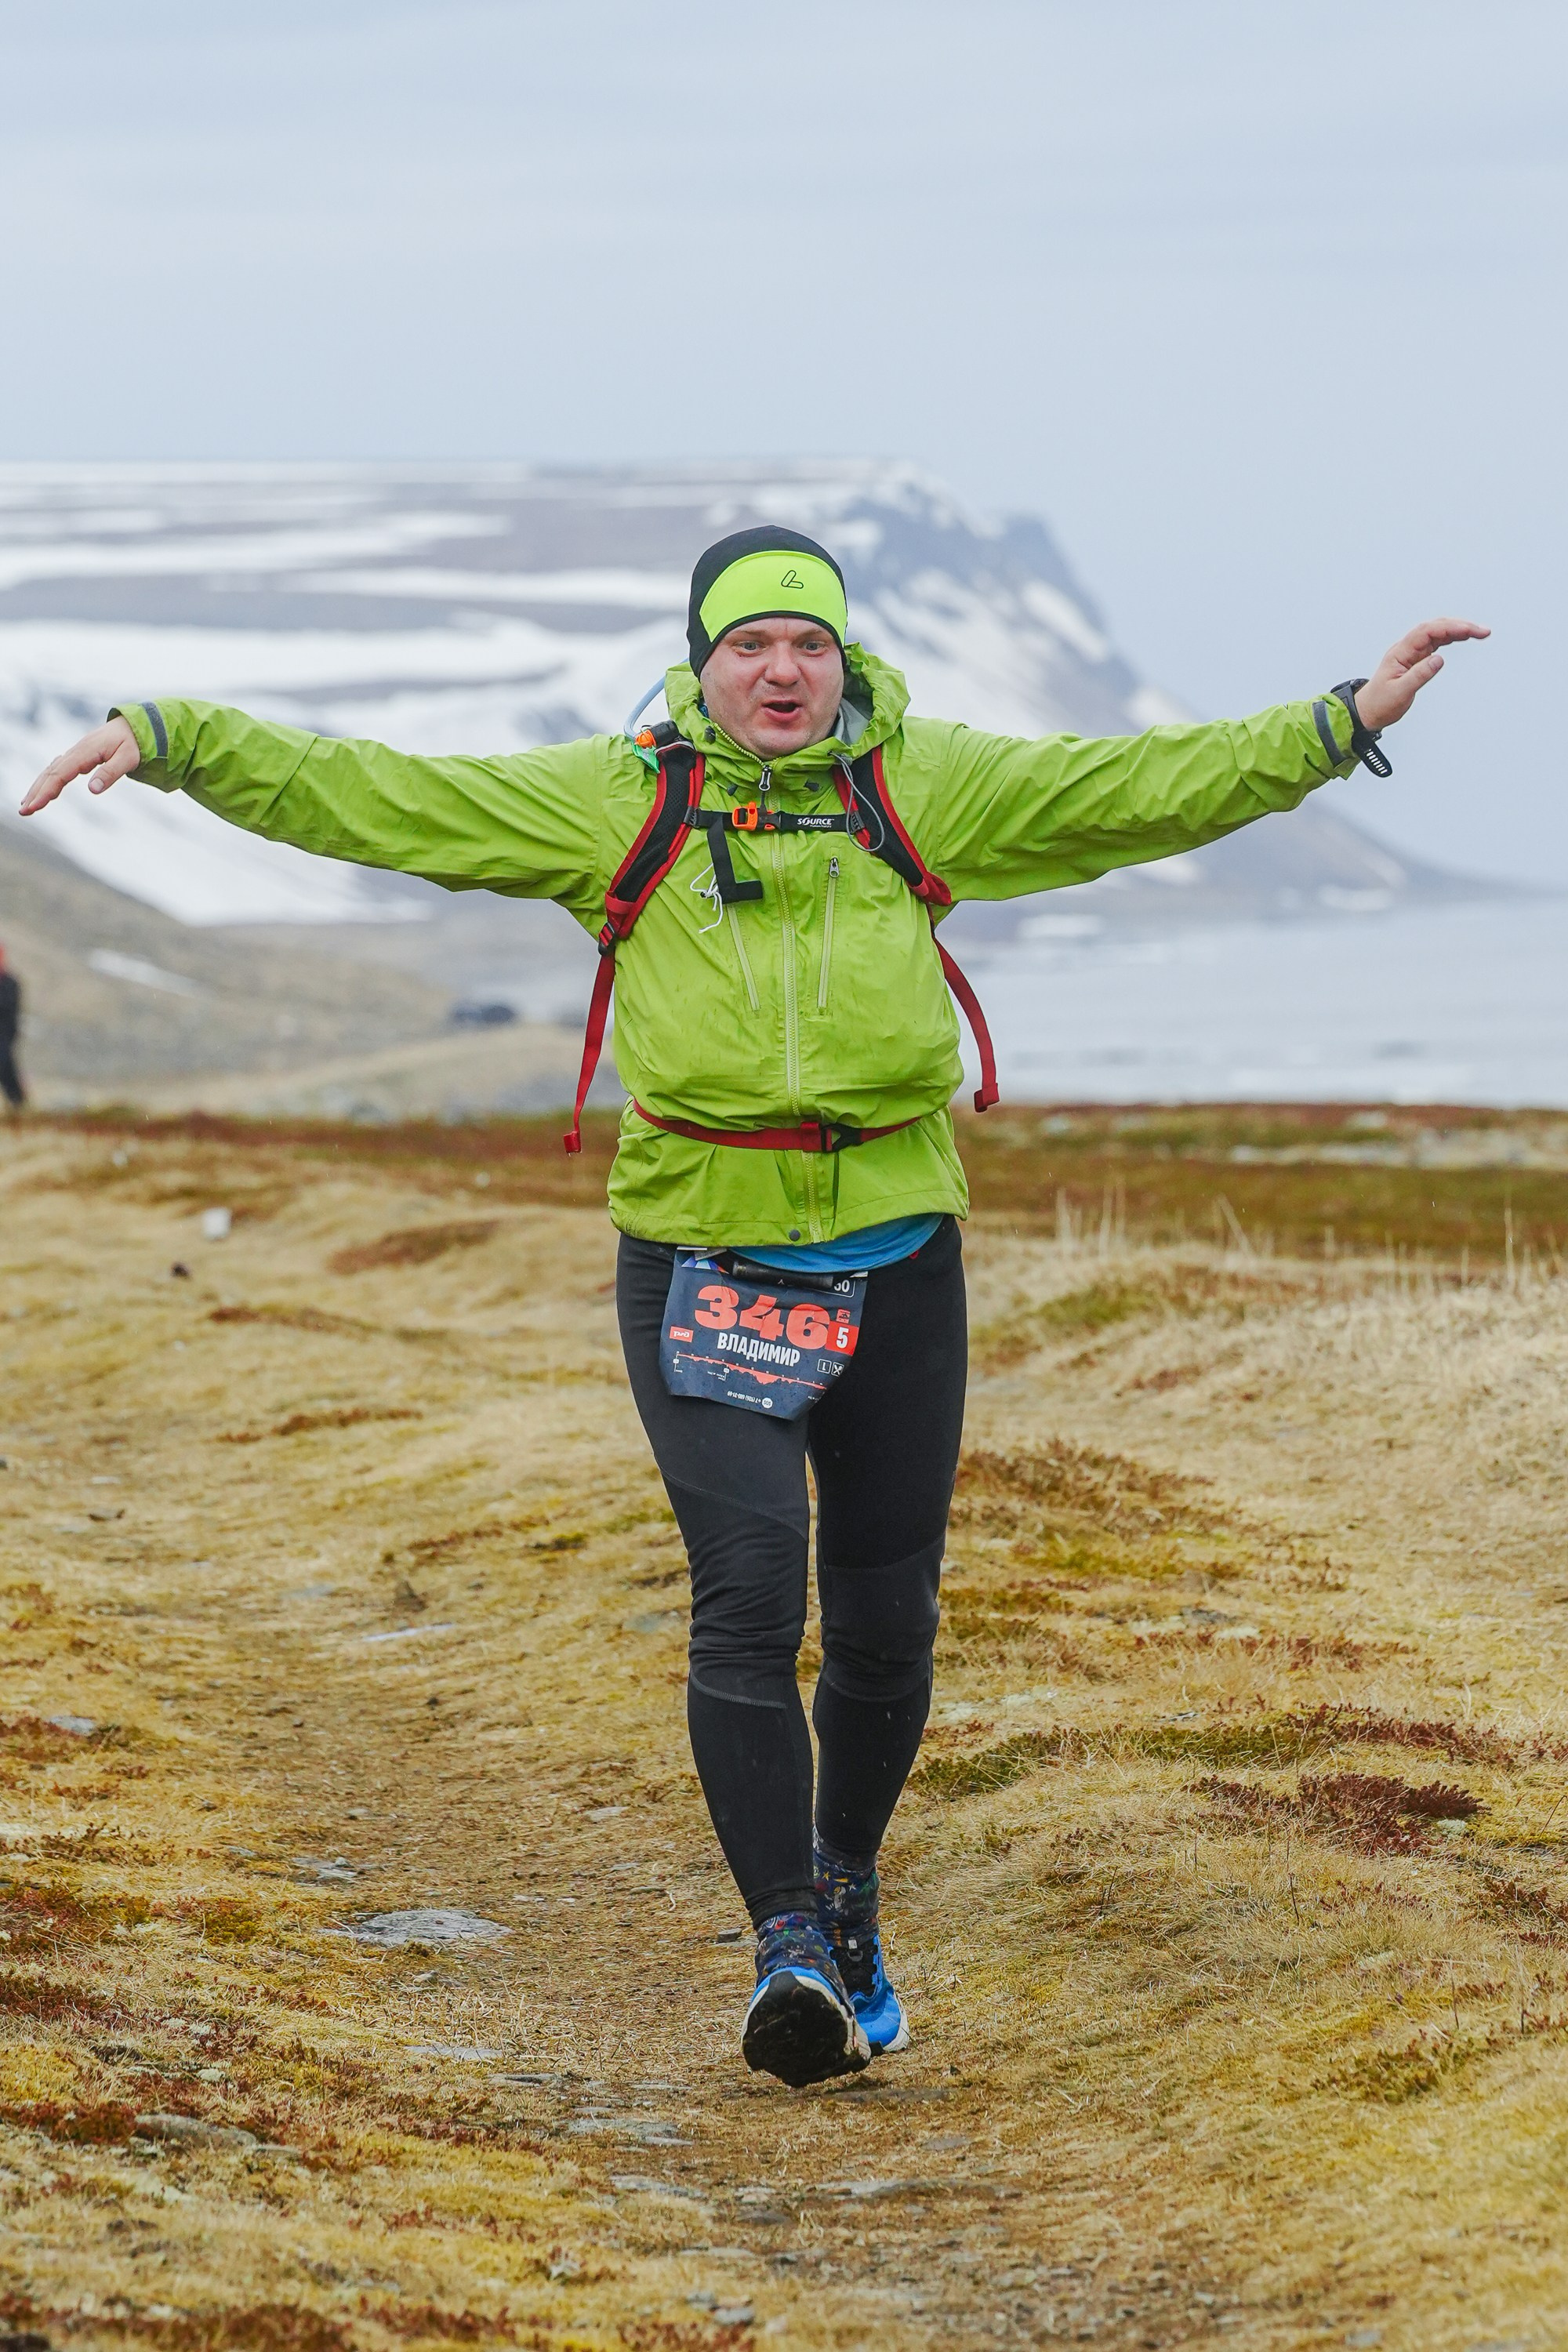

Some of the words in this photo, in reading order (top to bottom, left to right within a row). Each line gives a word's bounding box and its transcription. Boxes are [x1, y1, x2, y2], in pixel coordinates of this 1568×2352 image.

[797, 817, 833, 826] SOURCE
[695, 1285, 830, 1349] 346
[717, 1332, 800, 1367] ВЛАДИМИР
[836, 1327, 849, 1348] 5
